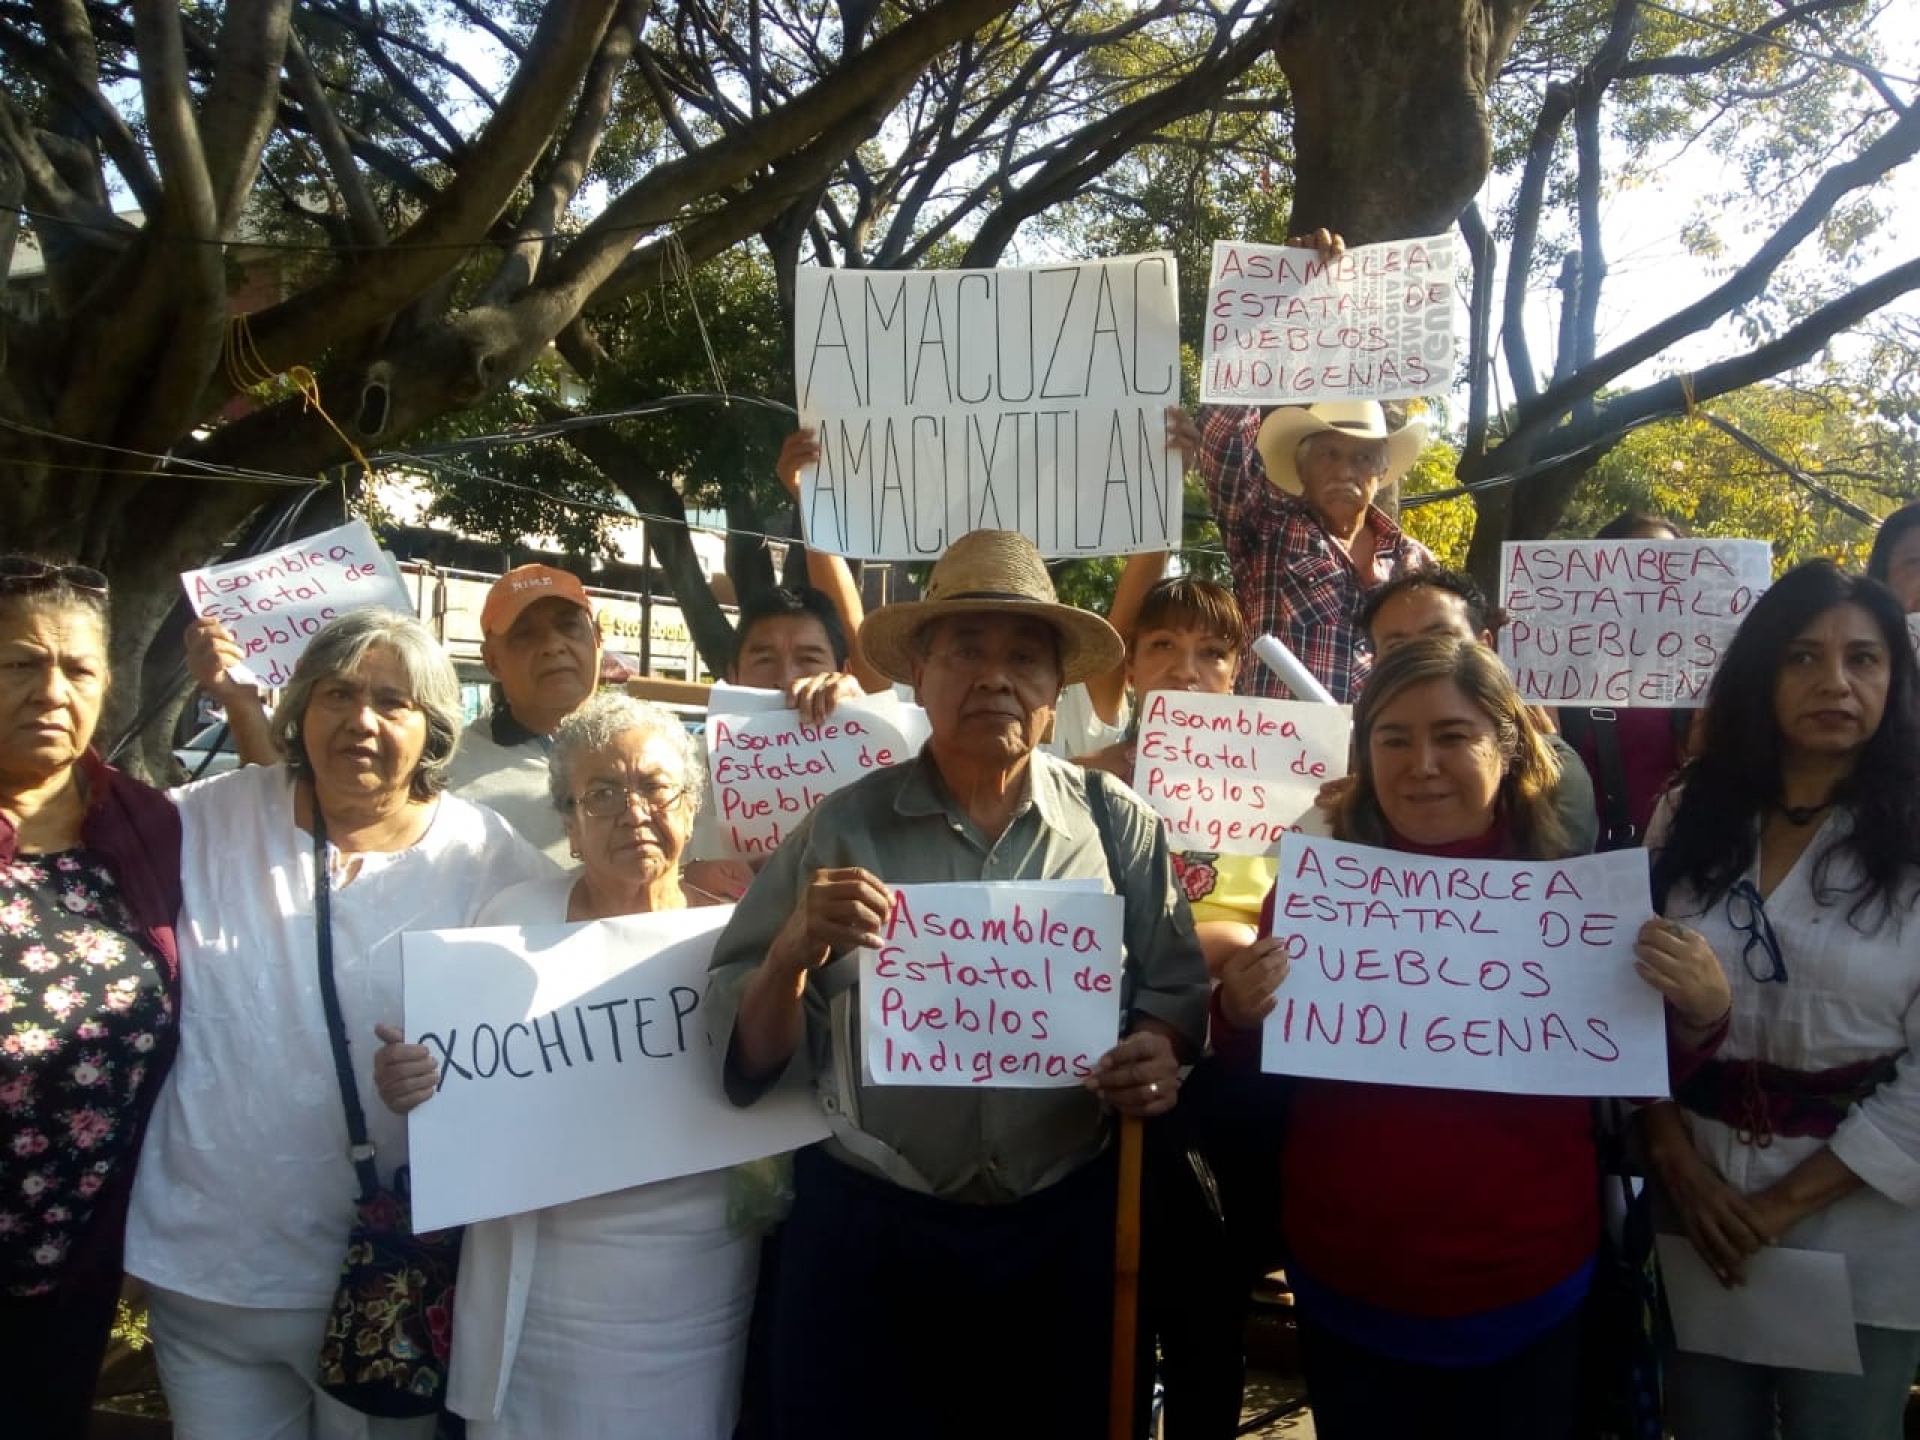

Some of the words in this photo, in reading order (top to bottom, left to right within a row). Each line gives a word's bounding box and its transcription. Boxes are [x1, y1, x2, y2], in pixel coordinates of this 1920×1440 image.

[1220, 246, 1432, 285] ASAMBLEA
[1213, 289, 1384, 320] ESTATAL
[1405, 283, 1445, 307] DE
[803, 257, 1172, 407] AMACUZAC
[1213, 324, 1389, 351] PUEBLOS
[1213, 356, 1431, 391] INDIGENAS
[810, 407, 1169, 555] AMACUXTITLAN
[195, 545, 354, 603] Asamblea
[201, 577, 327, 623] Estatal
[345, 563, 376, 582] de
[1508, 586, 1722, 618] ESTATAL
[1512, 620, 1717, 667] PUEBLOS
[1516, 665, 1707, 700] INDIGEN
[715, 720, 870, 753] Asamblea
[1148, 695, 1302, 741] Asamblea
[715, 750, 836, 785] Estatal
[858, 745, 895, 768] de
[1142, 731, 1258, 771] Estatal
[1290, 750, 1327, 778] de
[1148, 767, 1266, 810] Pueblos
[1162, 806, 1303, 850] ndigena
[1296, 846, 1583, 901] ASAMBLEA
[885, 889, 1102, 953] Asamblea
[1284, 893, 1498, 935] ESTATAL
[1539, 910, 1619, 949] DE
[875, 947, 1052, 993] Estatal
[1073, 966, 1113, 993] de
[881, 987, 1049, 1040] Pueblos
[1283, 997, 1620, 1062] INDIGENAS
[417, 986, 701, 1092] XOCHITEP
[885, 1038, 1093, 1083] Indigenas
